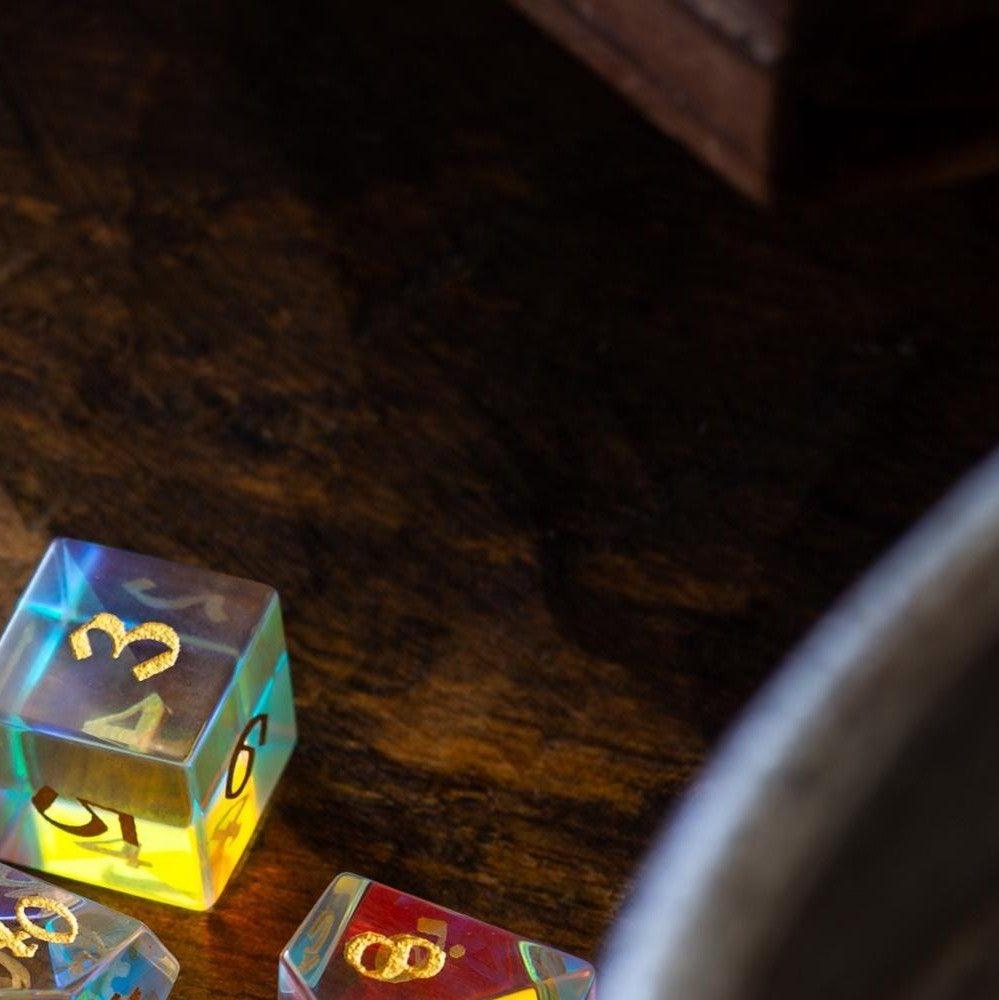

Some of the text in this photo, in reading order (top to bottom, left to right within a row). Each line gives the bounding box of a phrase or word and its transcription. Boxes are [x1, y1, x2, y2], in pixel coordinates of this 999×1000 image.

[69, 612, 180, 682] 3
[225, 713, 268, 799] 6
[31, 785, 141, 847] 5
[344, 930, 447, 984] 8
